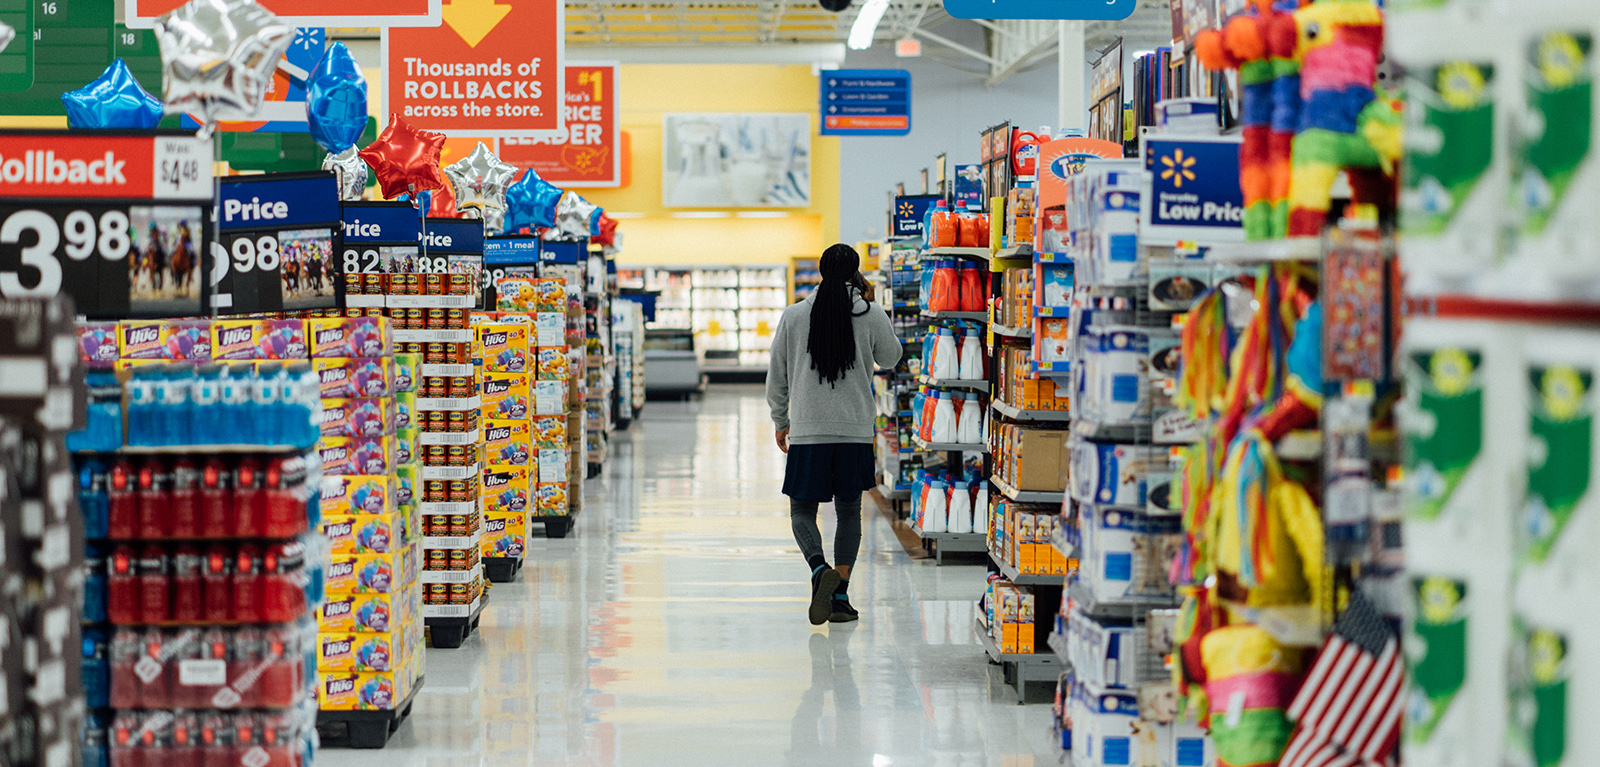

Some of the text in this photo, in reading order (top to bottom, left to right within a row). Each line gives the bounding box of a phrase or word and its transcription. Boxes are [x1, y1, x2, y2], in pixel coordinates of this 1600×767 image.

[42, 2, 57, 15] 16
[121, 34, 135, 45] 18
[404, 57, 541, 76] Thousands of
[404, 81, 542, 99] ROLLBACKS
[578, 71, 602, 102] #1
[404, 102, 543, 117] across the store.
[224, 196, 289, 222] Price
[1159, 202, 1201, 220] Low
[900, 222, 918, 231] Low
[514, 240, 534, 249] meal
[343, 249, 380, 273] 82
[130, 328, 158, 345] HUG
[222, 328, 251, 345] HUG
[319, 329, 343, 344] HUG
[485, 335, 506, 346] HUG
[322, 369, 346, 383] HUG
[489, 430, 509, 440] HUG
[323, 448, 346, 462] HUG
[328, 524, 351, 537] HUG
[485, 521, 504, 532] HUG
[328, 564, 352, 578] HUG
[326, 602, 350, 616] HUG
[326, 642, 350, 656] HUG
[329, 680, 353, 694] HUG
